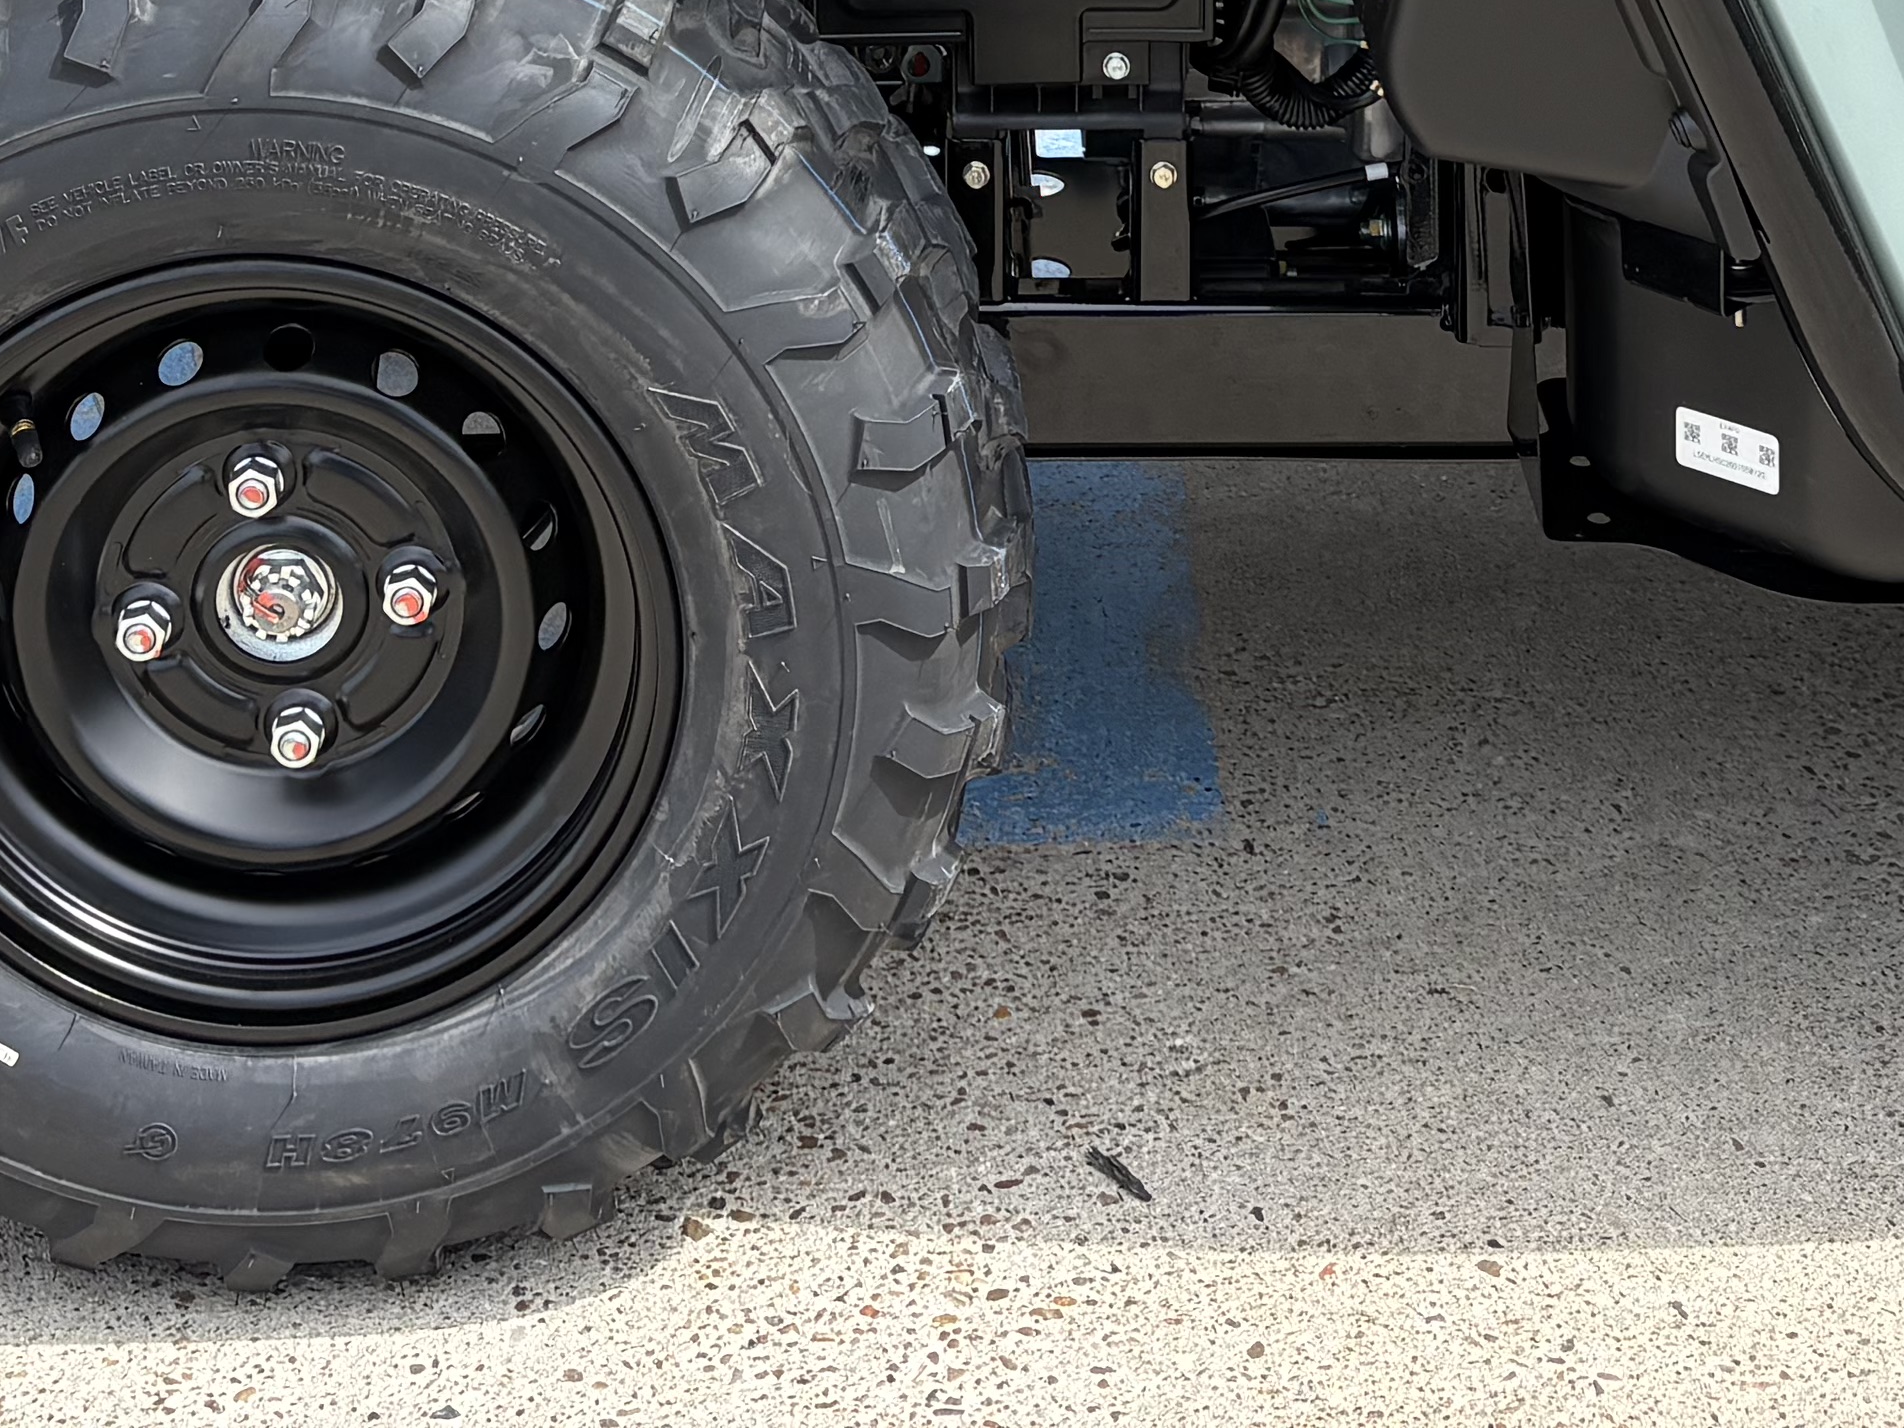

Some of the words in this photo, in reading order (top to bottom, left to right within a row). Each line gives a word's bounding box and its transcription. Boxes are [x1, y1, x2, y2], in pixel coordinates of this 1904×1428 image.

[250, 137, 346, 164] WARNING
[29, 195, 59, 217] SEE
[62, 175, 126, 202] VEHICLE
[128, 165, 179, 187] LABEL
[35, 213, 59, 232] DO
[62, 200, 94, 220] NOT
[167, 177, 229, 196] BEYOND
[567, 385, 801, 1070] MAXXIS
[264, 1066, 528, 1170] M978H
